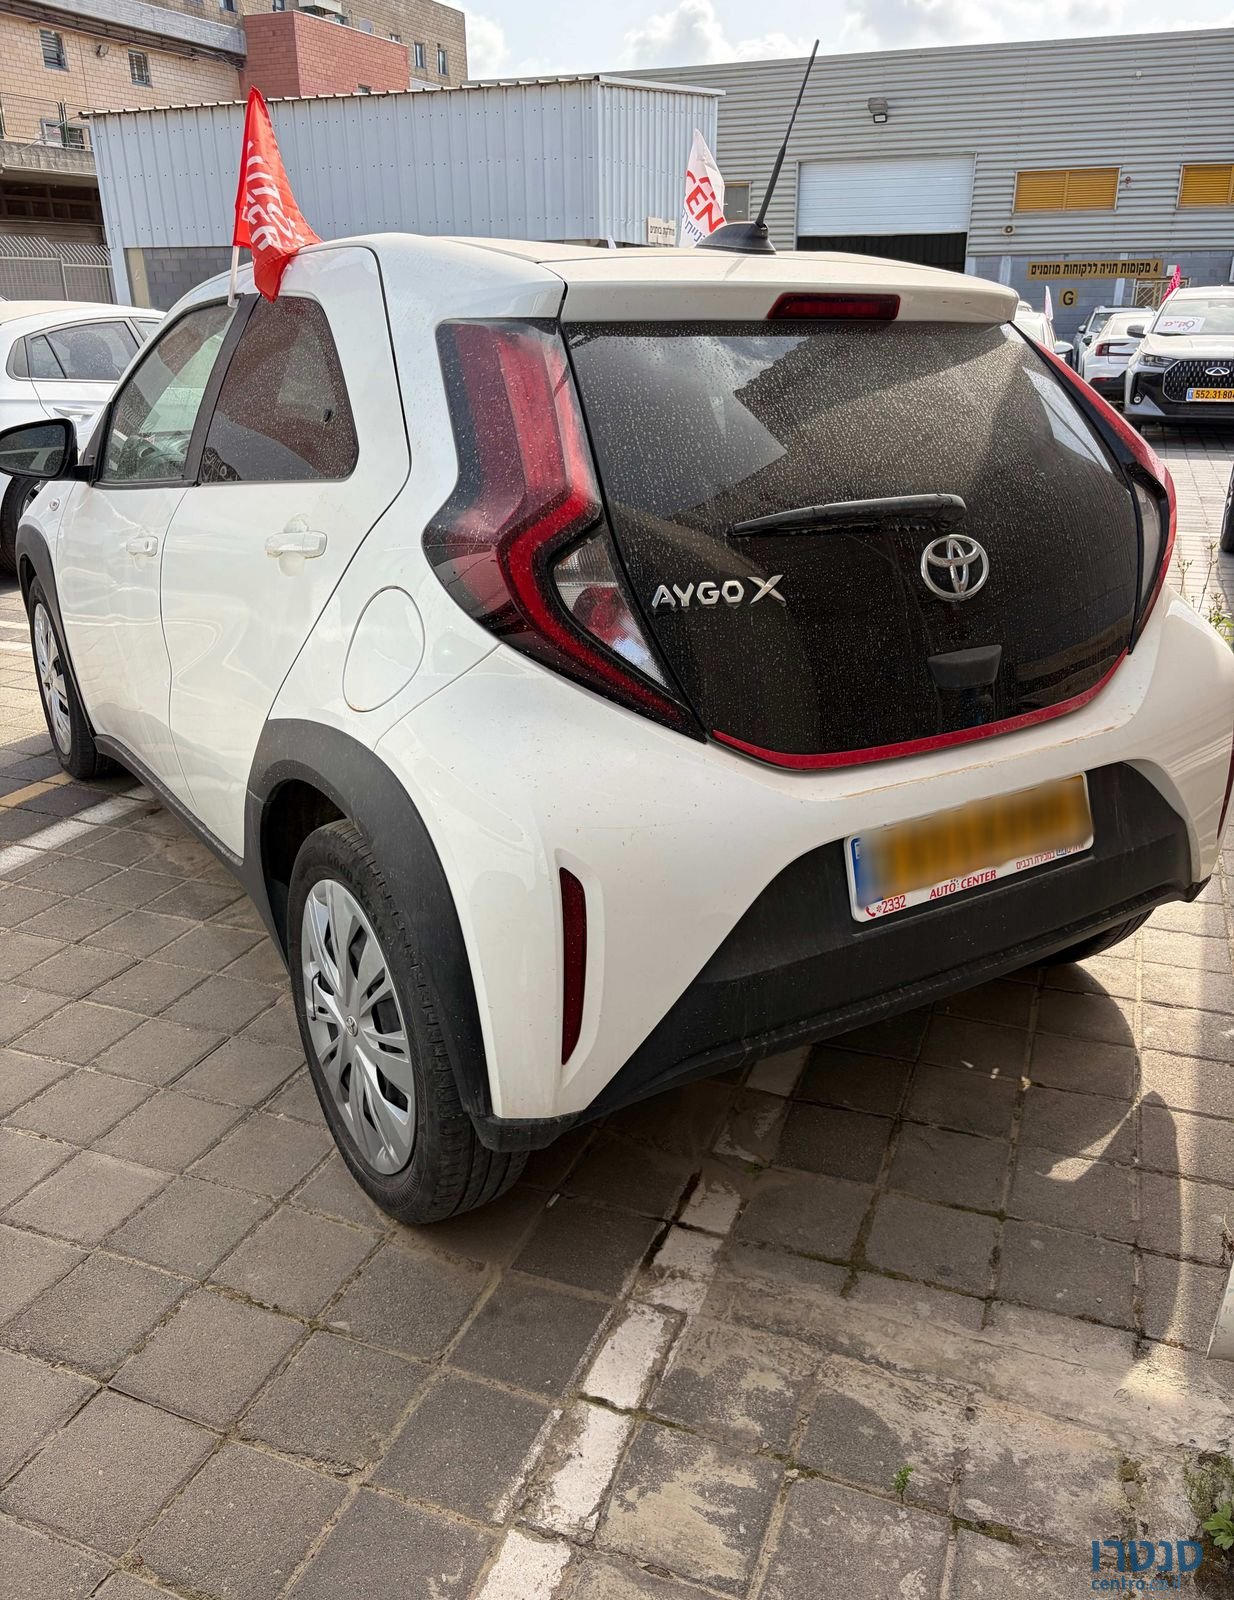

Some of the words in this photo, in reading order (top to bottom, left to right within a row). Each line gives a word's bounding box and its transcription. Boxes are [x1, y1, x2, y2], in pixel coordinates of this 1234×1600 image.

[1063, 262, 1098, 277] ללקוחות
[1100, 262, 1118, 274] חניה
[1120, 262, 1151, 276] מקומות
[1153, 262, 1159, 273] 4
[1063, 290, 1074, 306] G
[651, 579, 745, 608] AYGO
[748, 574, 787, 606] X
[1015, 857, 1034, 870] רכבים
[929, 881, 957, 899] AUTO
[960, 869, 997, 889] CENTER
